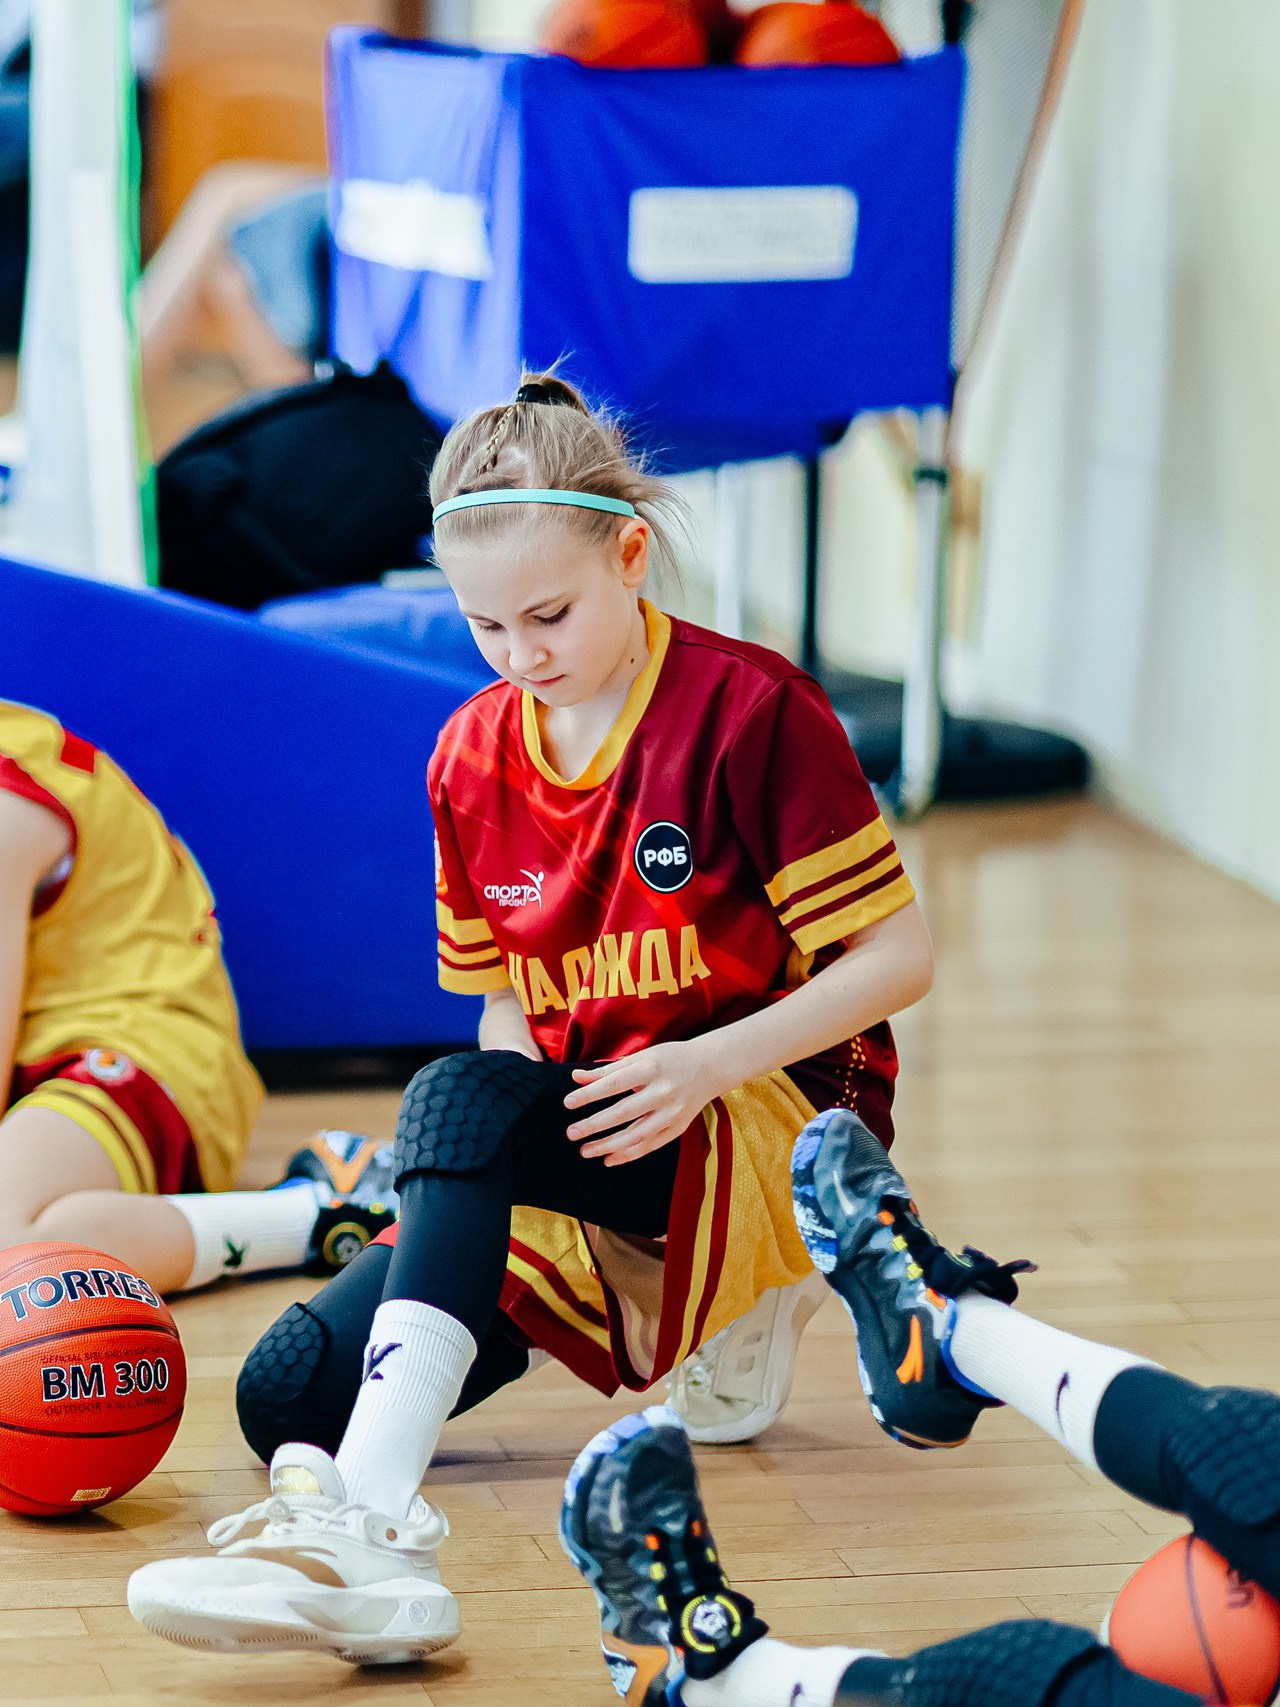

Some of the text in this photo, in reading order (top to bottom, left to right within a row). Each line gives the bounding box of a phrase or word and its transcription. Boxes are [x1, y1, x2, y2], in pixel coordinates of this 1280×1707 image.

[643, 845, 687, 868] РФБ
[483, 885, 529, 900] СПОРТ
[508, 924, 712, 1016] НАДЖДА
[41, 1357, 170, 1403] BM 300
[44, 1402, 102, 1416] OUTDOOR
[115, 1400, 133, 1409] ALL
